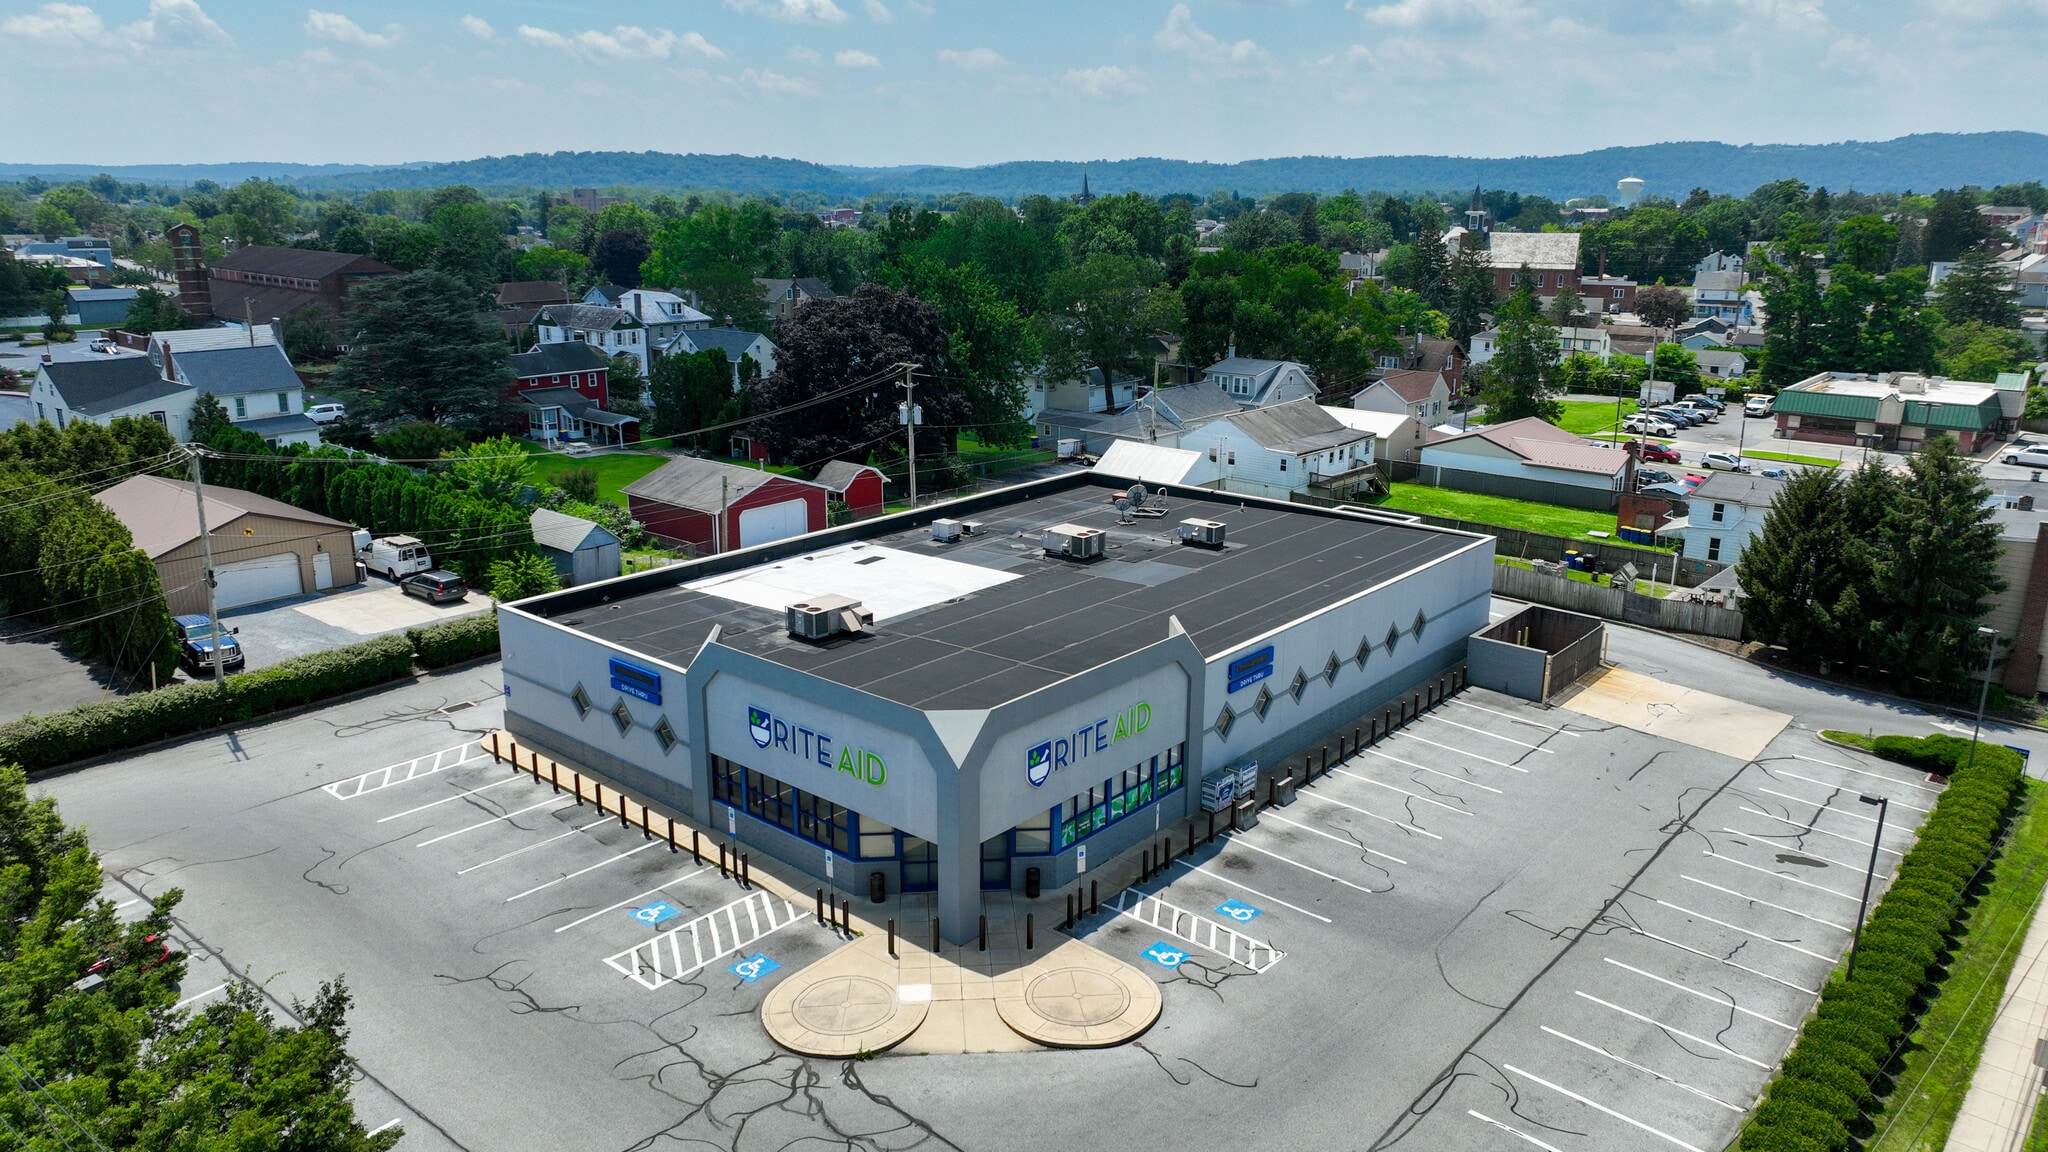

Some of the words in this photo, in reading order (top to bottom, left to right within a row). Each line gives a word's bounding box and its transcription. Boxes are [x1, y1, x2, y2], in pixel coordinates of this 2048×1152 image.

[621, 684, 636, 695] DRIVE
[1240, 677, 1253, 687] DRIVE
[773, 718, 833, 769] RITE
[837, 744, 887, 786] AID
[1053, 719, 1109, 772] RITE
[1111, 702, 1152, 745] AID
